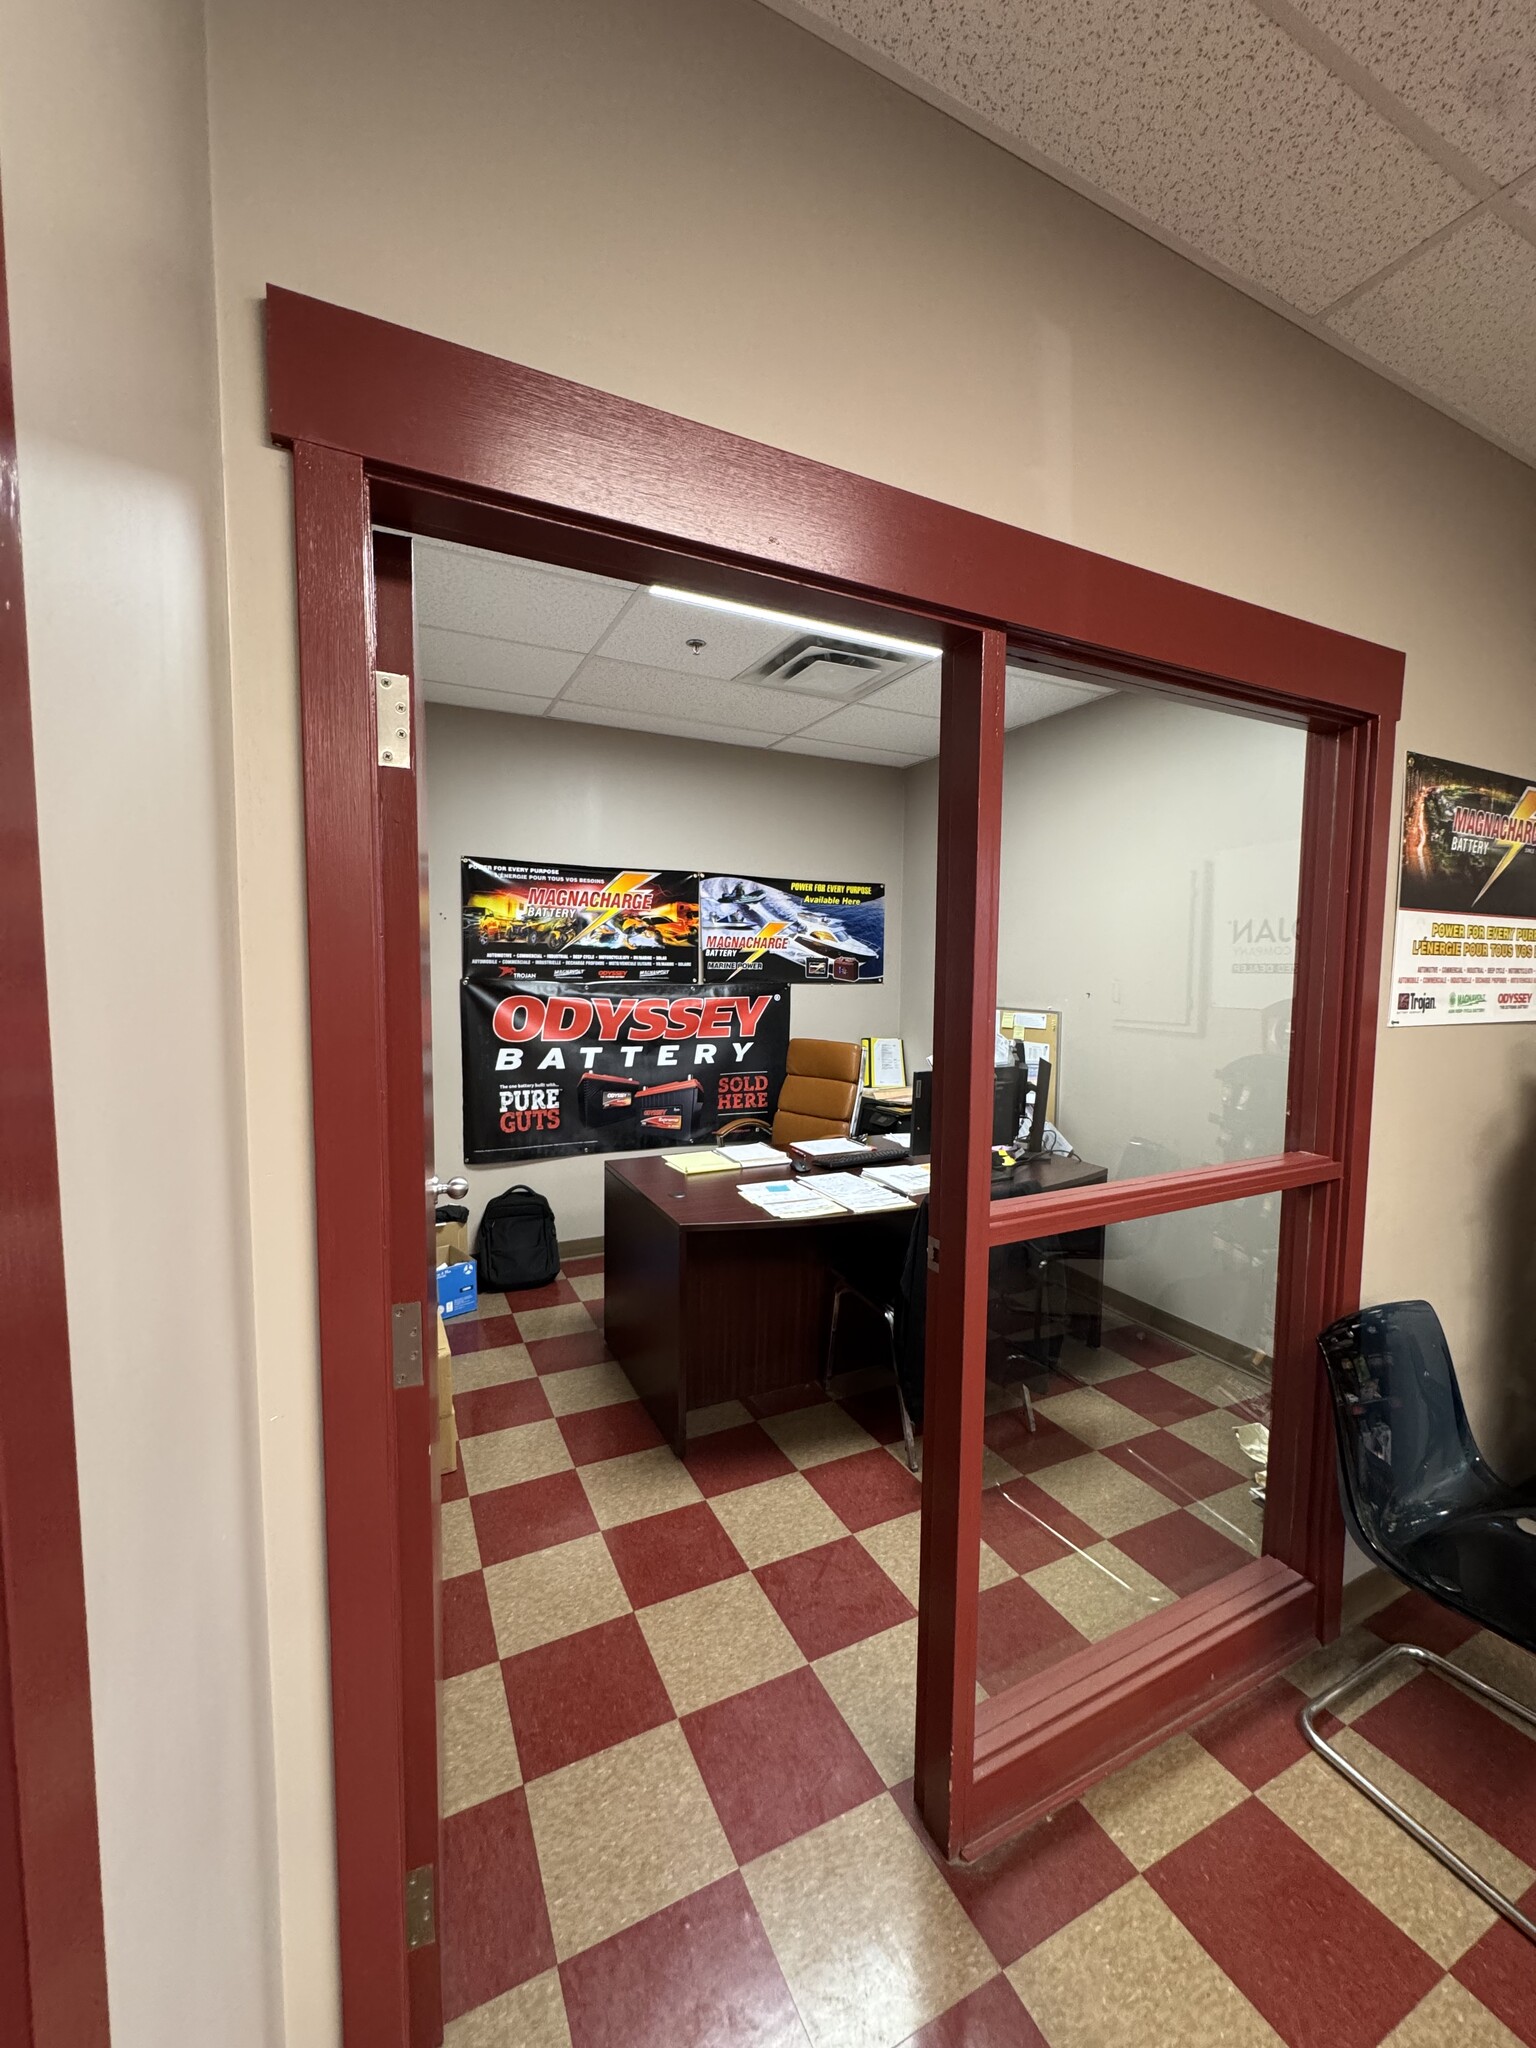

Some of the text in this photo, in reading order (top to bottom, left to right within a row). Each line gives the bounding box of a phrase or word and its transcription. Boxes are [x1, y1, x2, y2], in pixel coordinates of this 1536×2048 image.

[1451, 836, 1490, 855] BATTERY
[508, 866, 529, 874] EVERY
[530, 867, 560, 875] PURPOSE
[790, 882, 872, 895] POWER FOR EVERY PURPOSE
[527, 887, 654, 911] MAGNACHARGE
[803, 895, 861, 906] Available Here
[527, 906, 576, 918] BATTERY
[1432, 923, 1465, 938] POWER
[1467, 925, 1485, 938] FOR
[1487, 926, 1515, 940] EVERY
[706, 936, 789, 950] MAGNACHARGE
[1412, 936, 1533, 958] L'ÉNERGIE POUR TOUS VOS
[705, 949, 737, 957] BATTERY
[737, 962, 763, 970] POWER
[1410, 992, 1436, 1013] Trojan
[1497, 993, 1532, 1004] ODYSSEY
[492, 995, 772, 1043] ODYSSEY
[495, 1042, 754, 1071] BATTERY
[718, 1075, 769, 1093] SOLD
[499, 1089, 560, 1112] PURE
[718, 1092, 768, 1109] HERE
[500, 1109, 560, 1133] GUTS
